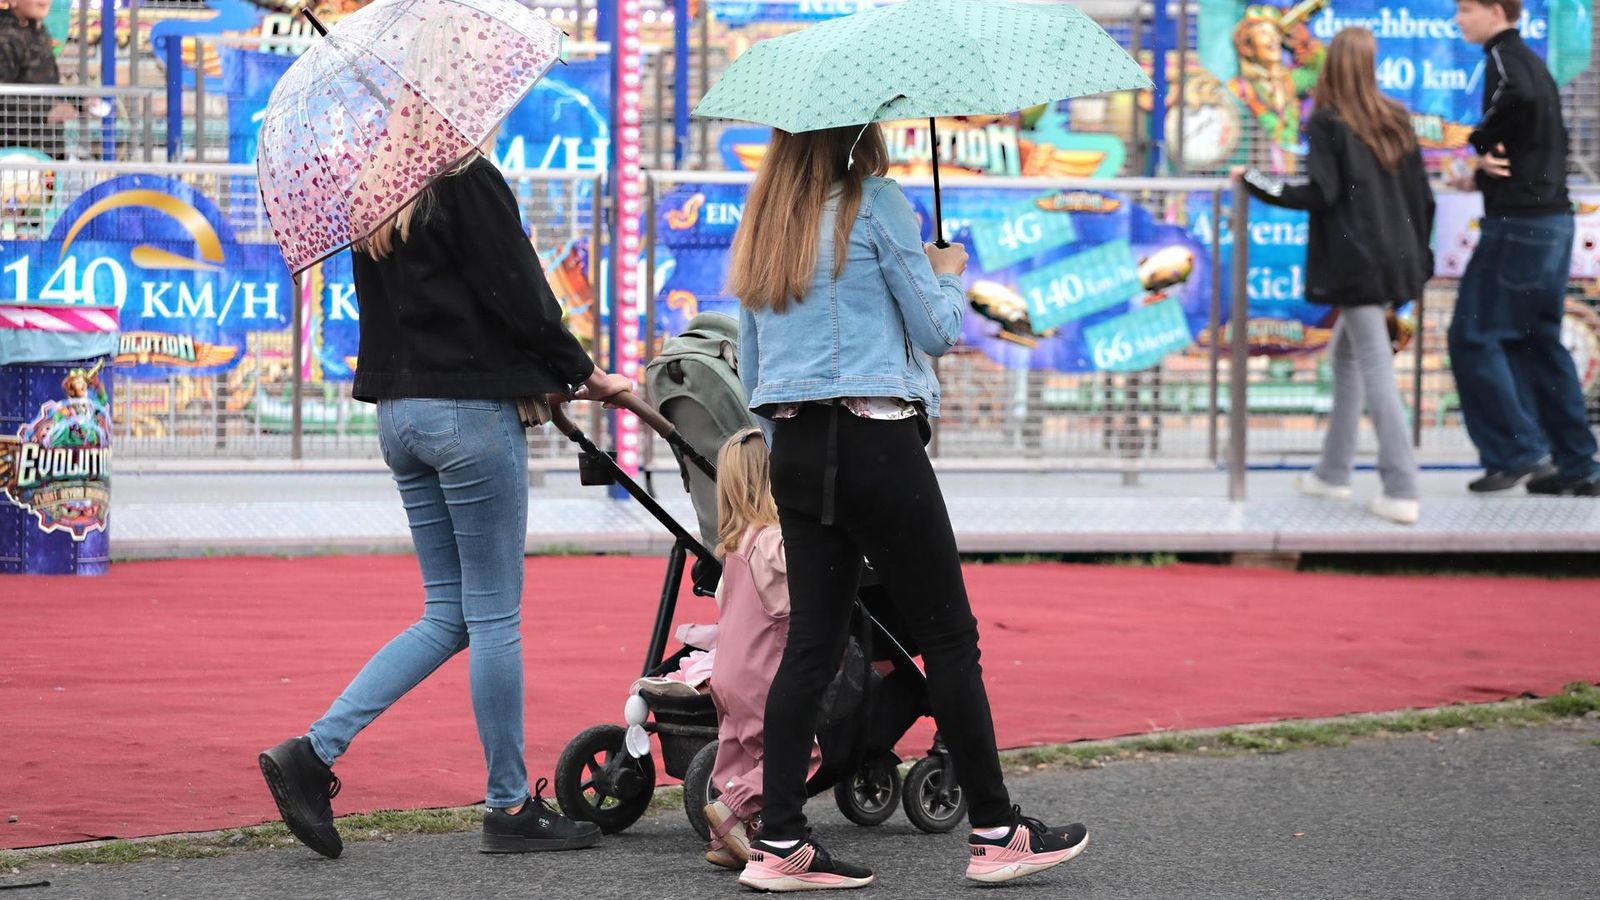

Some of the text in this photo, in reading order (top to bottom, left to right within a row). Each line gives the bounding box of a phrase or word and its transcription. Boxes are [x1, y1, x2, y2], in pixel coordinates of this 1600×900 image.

[1376, 57, 1487, 95] 40 km/
[490, 134, 611, 174] M/H
[705, 202, 745, 225] EIN
[998, 211, 1043, 249] 4G
[3, 254, 279, 327] 140 KM/H
[1029, 272, 1084, 315] 140
[119, 333, 197, 362] OLUTION
[1093, 330, 1134, 369] 66
[18, 441, 112, 487] EVOLUTIO
